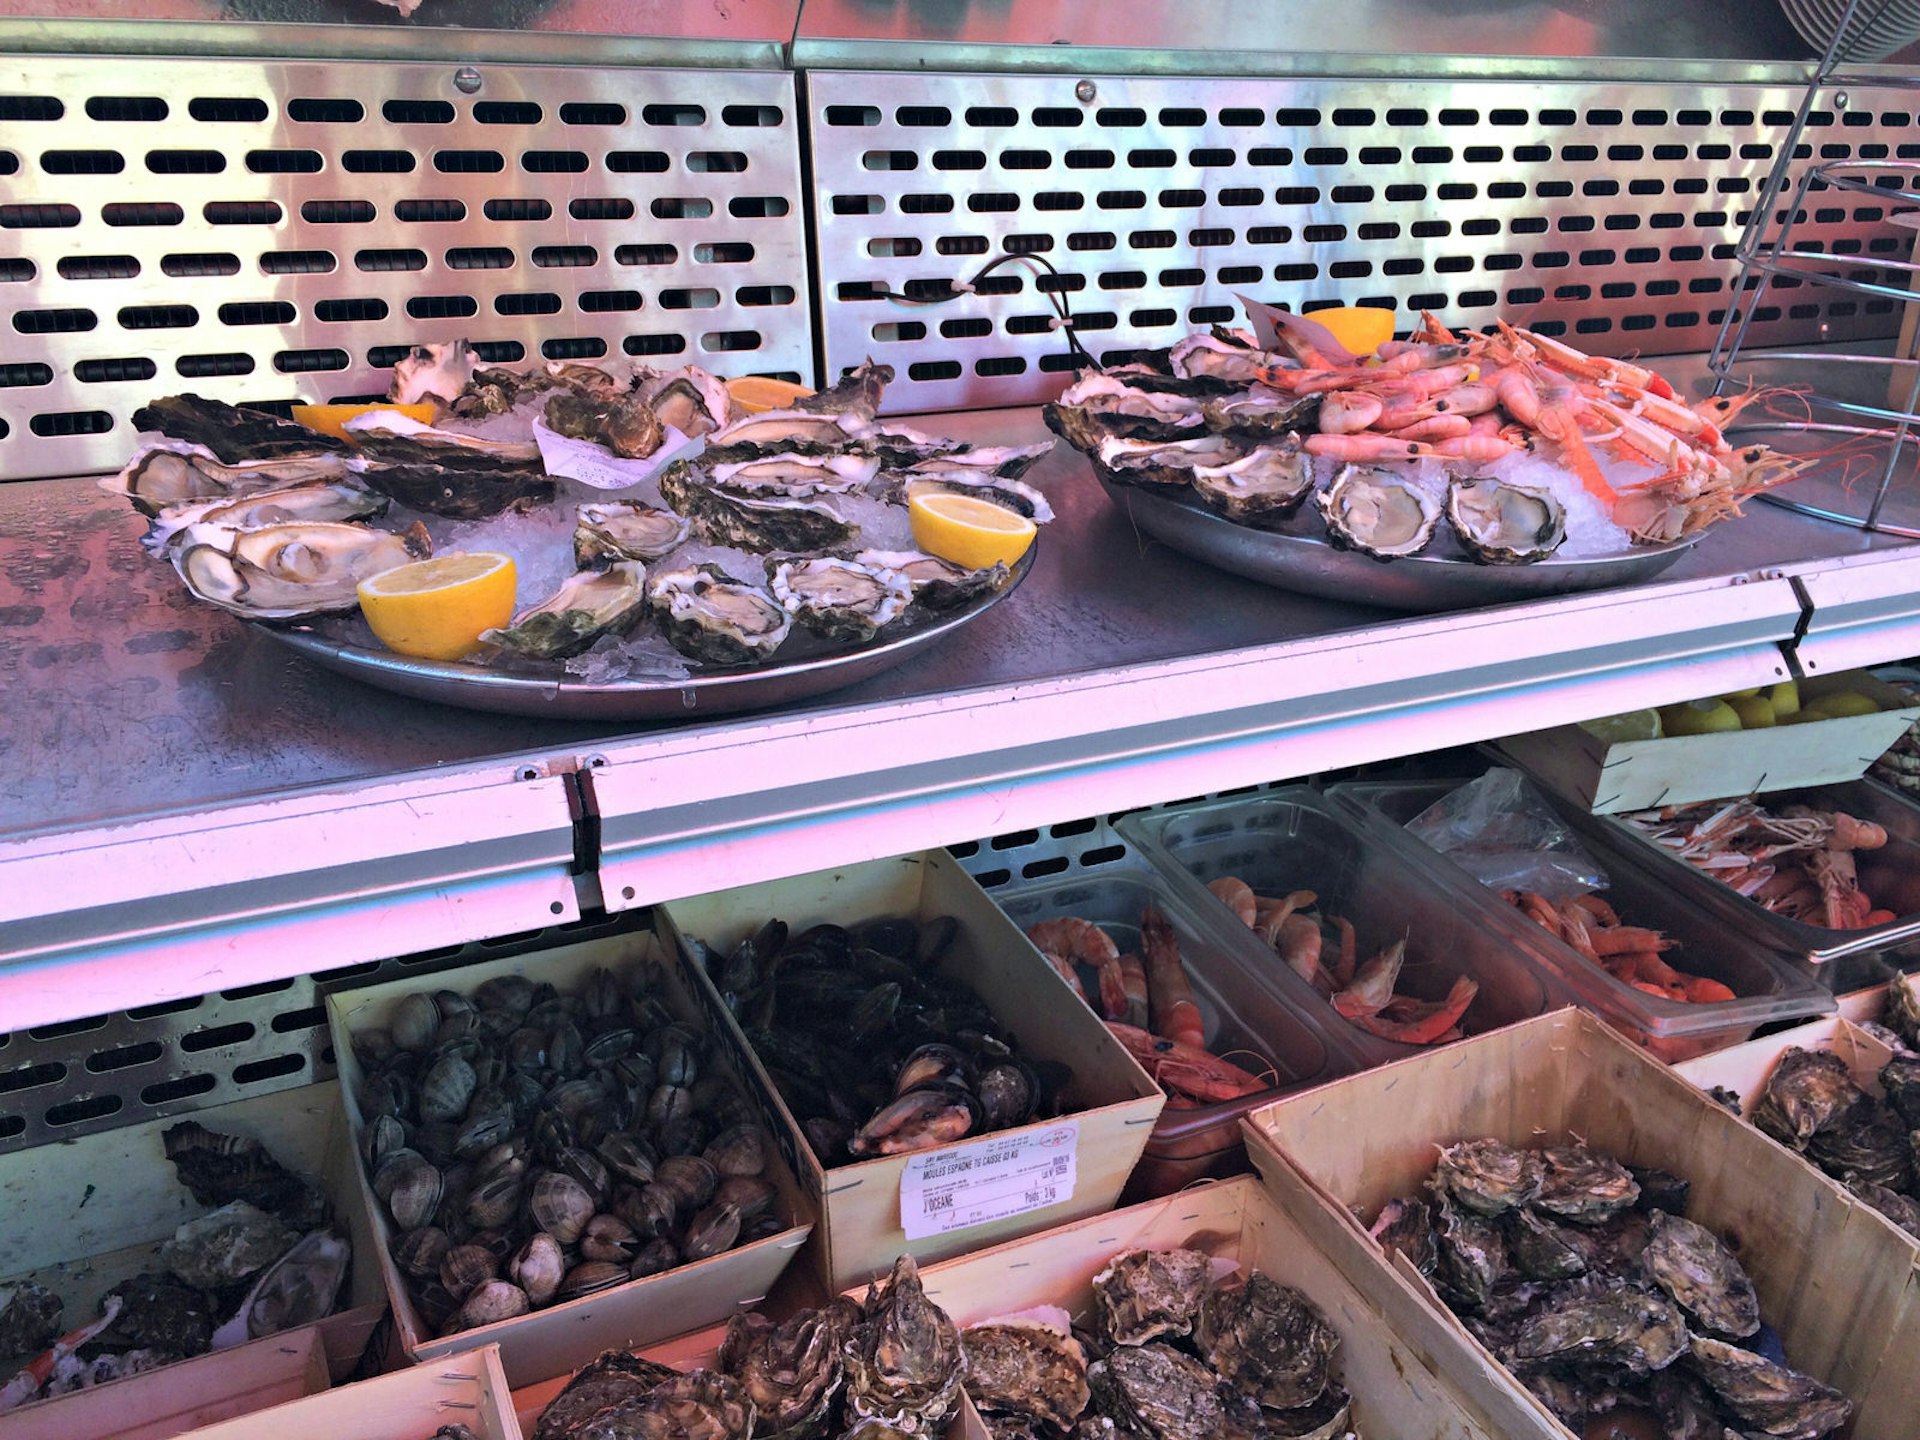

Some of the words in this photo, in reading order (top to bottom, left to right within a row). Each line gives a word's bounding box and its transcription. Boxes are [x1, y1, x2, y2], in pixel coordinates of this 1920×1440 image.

[923, 1166, 946, 1180] MOULES
[948, 1159, 972, 1174] ESPAGNE
[982, 1152, 1001, 1166] CAISSE
[1011, 1149, 1019, 1159] KG
[1025, 1190, 1039, 1204] Poids
